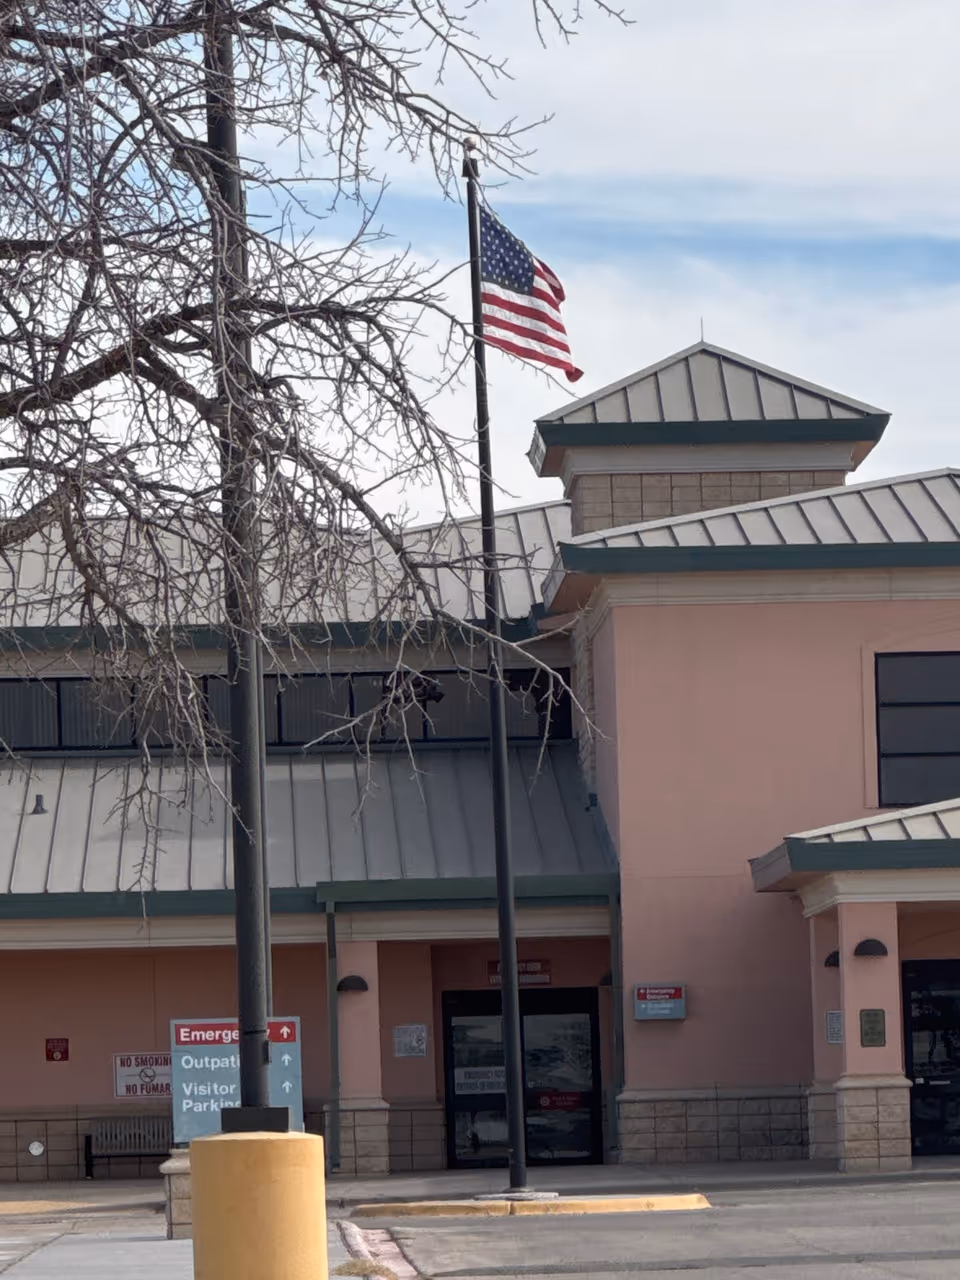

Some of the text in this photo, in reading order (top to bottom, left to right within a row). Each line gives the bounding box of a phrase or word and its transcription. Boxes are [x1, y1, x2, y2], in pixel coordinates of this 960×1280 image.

[120, 1056, 172, 1068] NO SMOKIN
[181, 1055, 240, 1071] Outpati
[125, 1082, 171, 1095] NO FUMAR
[182, 1082, 236, 1096] Visitor
